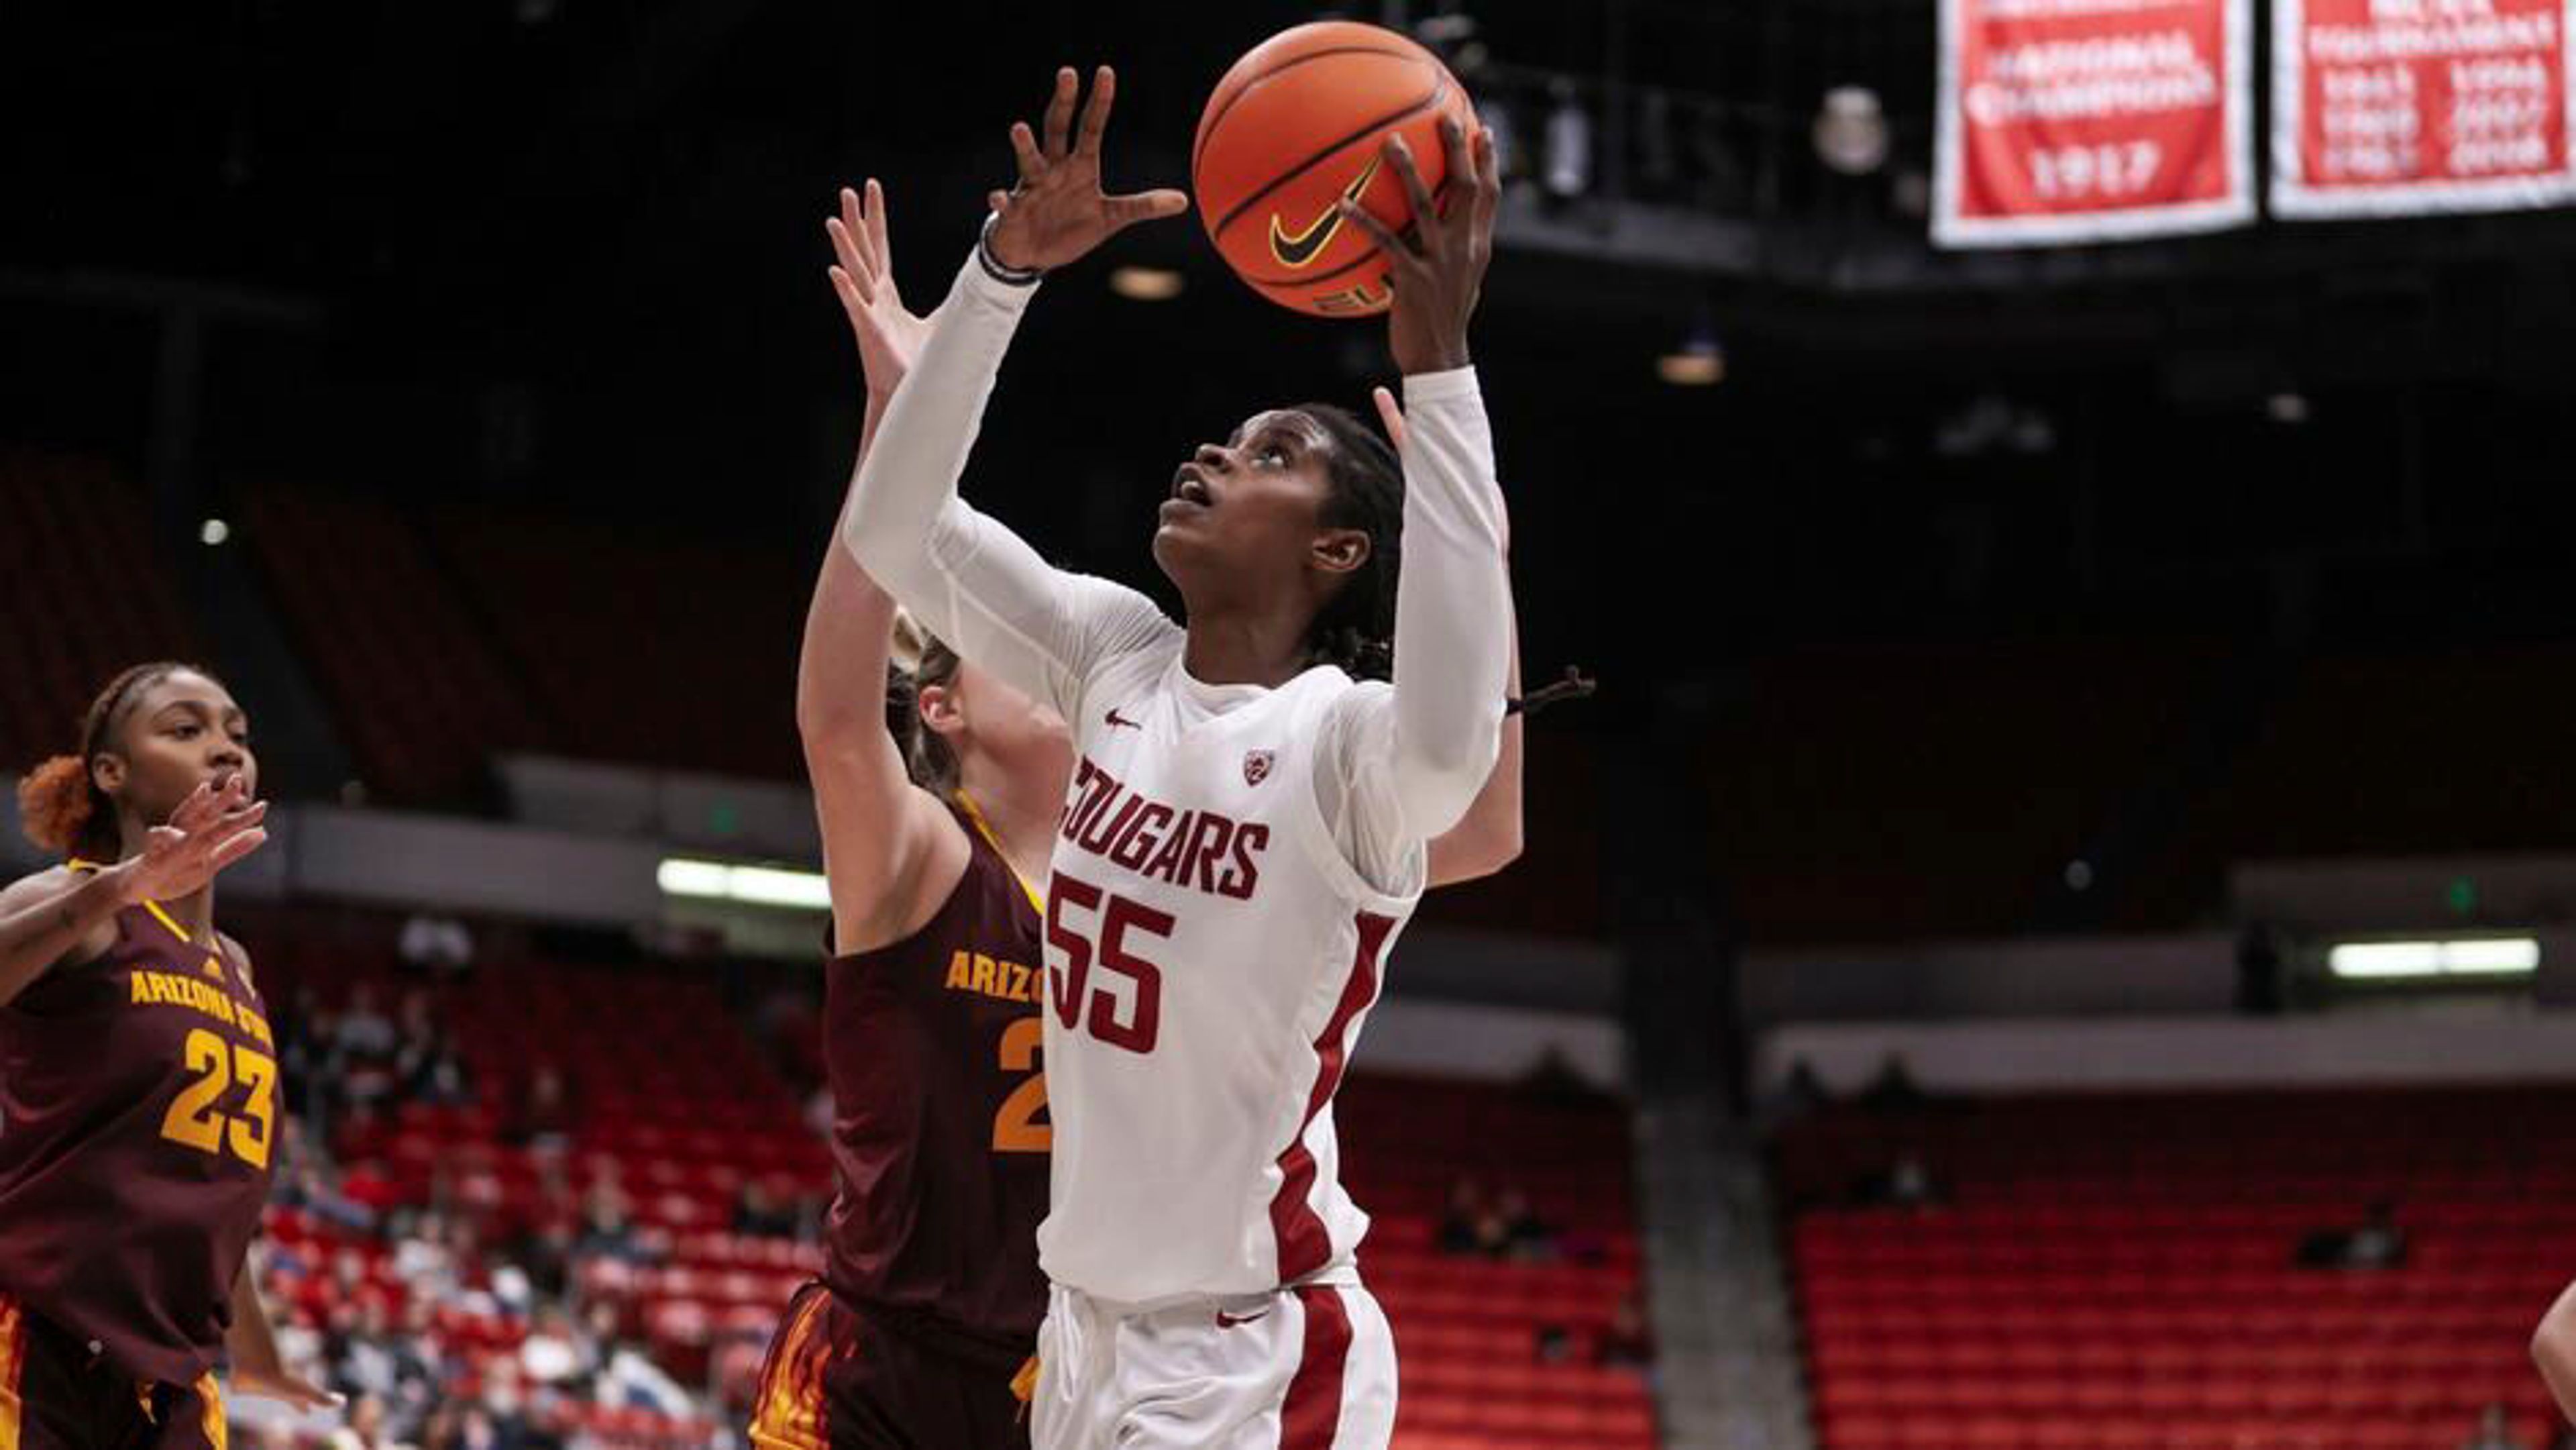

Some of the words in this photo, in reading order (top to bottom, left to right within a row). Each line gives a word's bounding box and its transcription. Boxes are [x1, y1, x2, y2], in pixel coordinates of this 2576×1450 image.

[2029, 139, 2161, 197] 1917
[131, 970, 235, 1027] ARIZONA
[1044, 870, 1175, 1055] 55
[161, 1028, 277, 1170] 23
